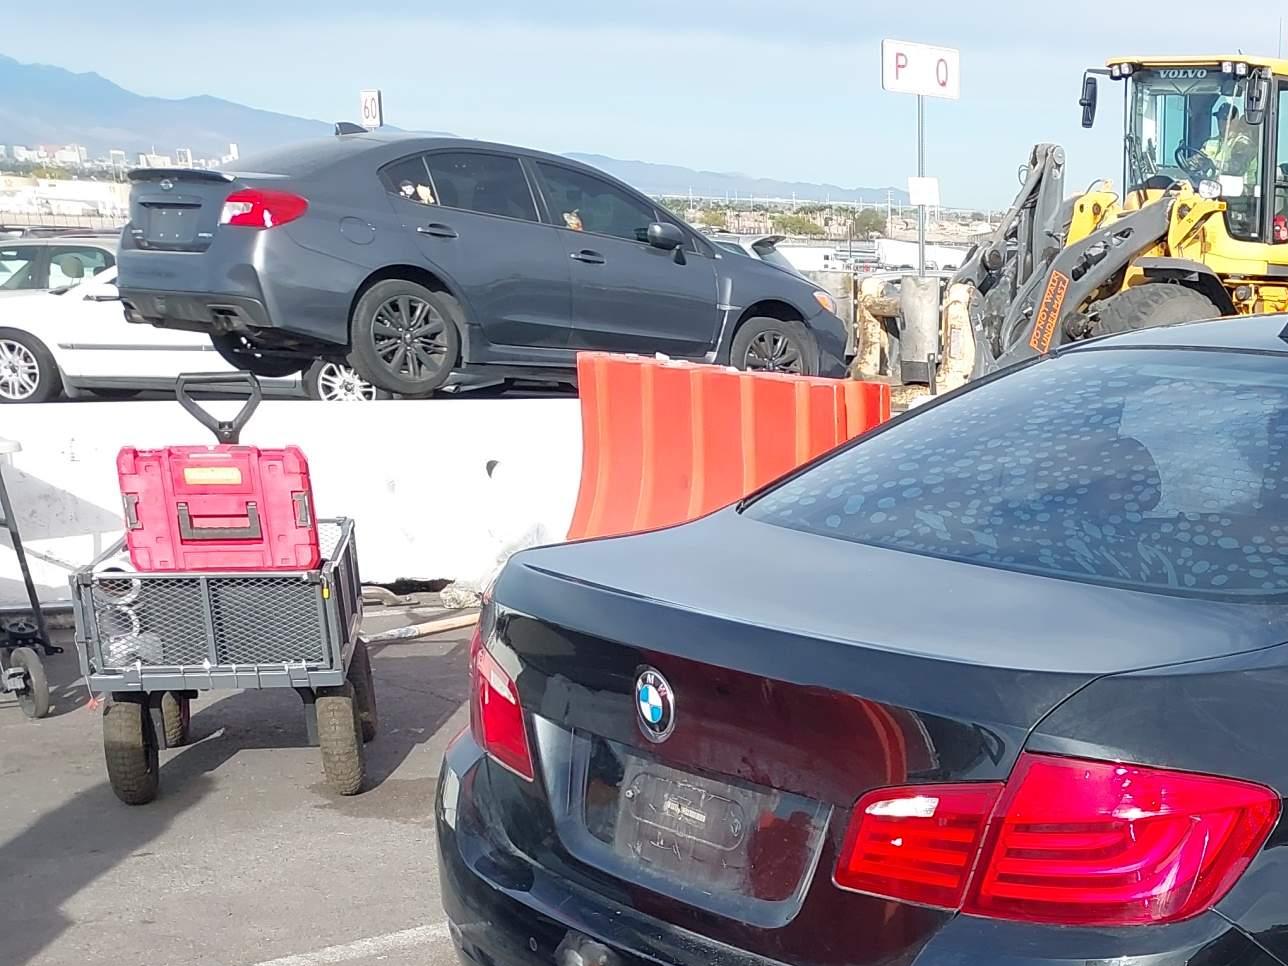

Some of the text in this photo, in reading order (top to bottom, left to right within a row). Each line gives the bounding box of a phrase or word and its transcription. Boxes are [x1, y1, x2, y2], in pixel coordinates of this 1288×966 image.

[895, 52, 949, 87] P Q
[1160, 69, 1207, 79] VOLVO
[363, 96, 377, 119] 60
[1031, 271, 1060, 346] DO NOT WALK
[1041, 281, 1066, 346] UNDER MAST
